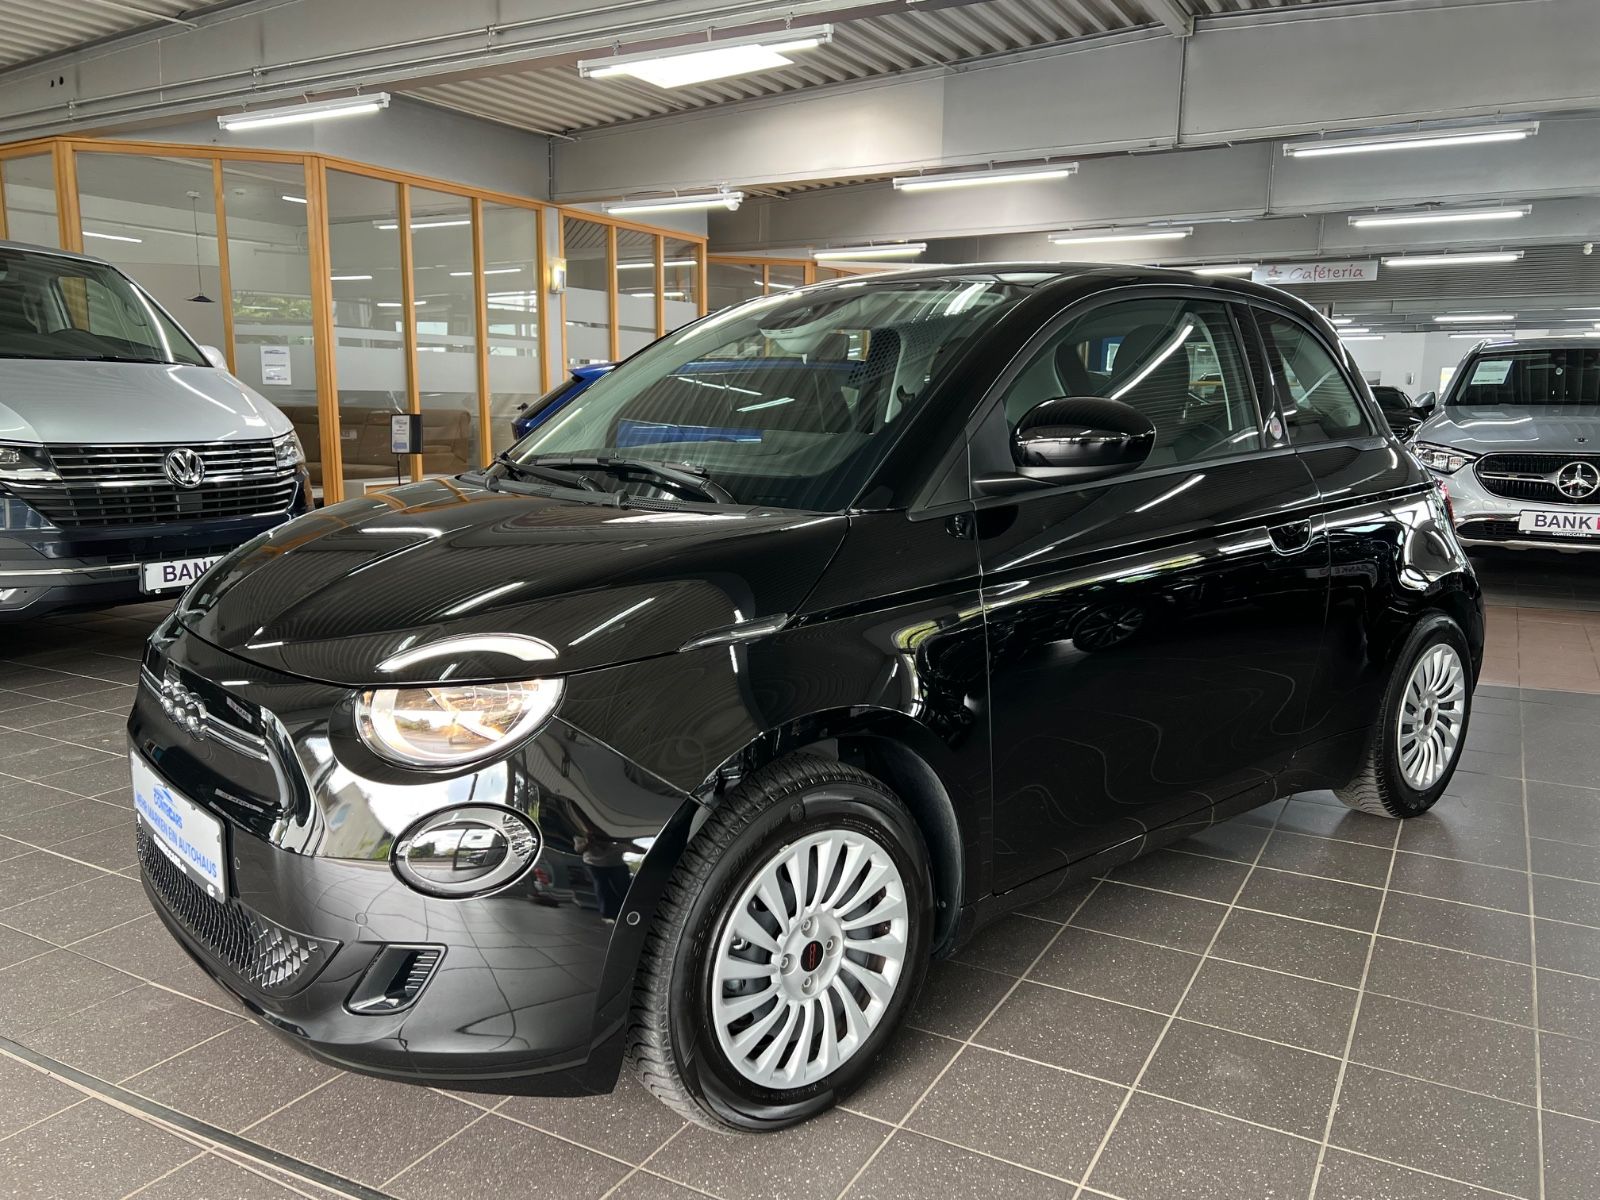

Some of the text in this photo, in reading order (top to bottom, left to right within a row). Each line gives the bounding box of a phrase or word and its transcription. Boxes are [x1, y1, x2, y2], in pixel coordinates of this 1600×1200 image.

[1288, 264, 1364, 281] Caféteria
[1534, 514, 1592, 530] BANK
[162, 560, 214, 583] BAN
[178, 836, 217, 878] AUTOHAUS
